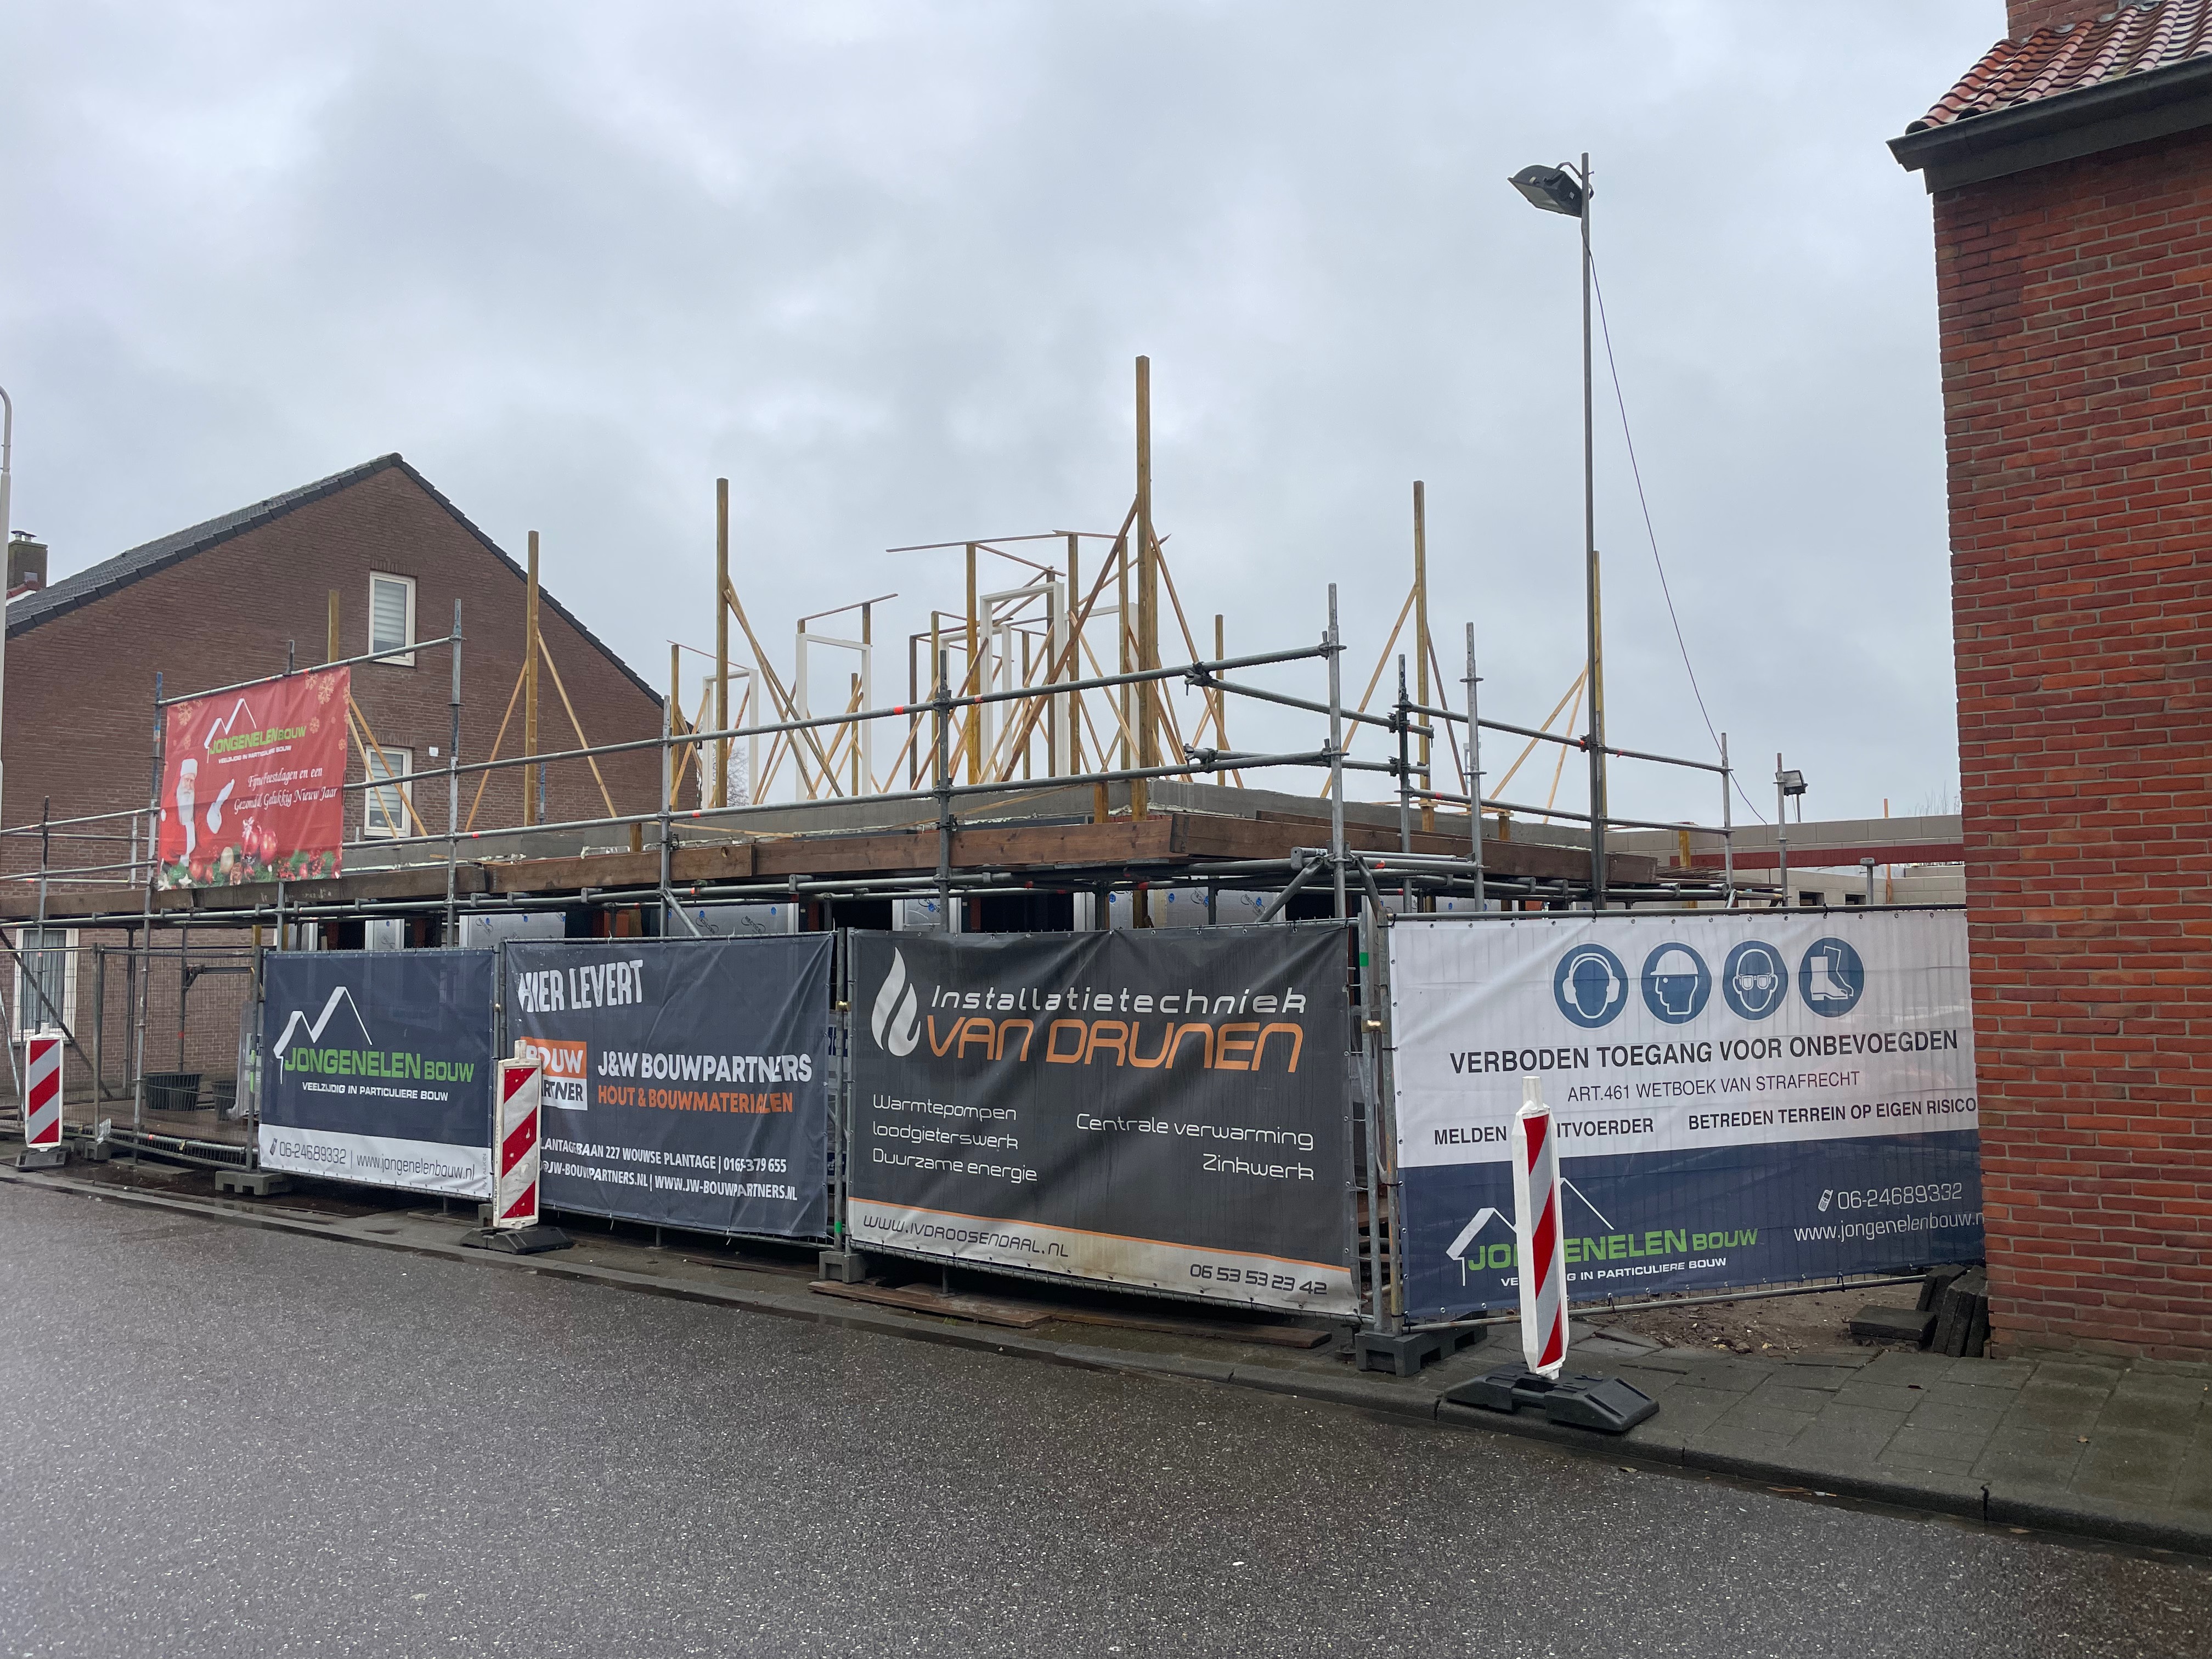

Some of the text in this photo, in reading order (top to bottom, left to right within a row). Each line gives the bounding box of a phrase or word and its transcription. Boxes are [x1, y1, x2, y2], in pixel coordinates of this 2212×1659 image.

[210, 727, 278, 754] JONGENELEN
[300, 769, 308, 779] en
[311, 768, 323, 777] een
[263, 789, 292, 810] Gelukkig
[294, 788, 320, 803] Nieuw
[320, 786, 338, 801] Jaar
[518, 960, 643, 1012] HIER LEVERT
[932, 985, 1306, 1014] Installatietechniek
[927, 1015, 1303, 1073] VAN DRUNEN
[1450, 1029, 1957, 1074] VERBODEN TOEGANG VOOR ONBEVOEGDEN
[285, 1048, 474, 1083] JONGENELEN BOUW
[598, 1051, 812, 1083] J&W BOUWPARTNERS
[302, 1081, 449, 1102] VEELZIJDIG IN PARTICULIERE BOUW
[541, 1080, 584, 1101] RTNER
[598, 1085, 793, 1114] HOUT & BOUWMATERIALEN
[1567, 1071, 1860, 1102] ART.461 WETBOEK VAN STRAFRECHT
[873, 1094, 1016, 1122] Warmtepompen
[1689, 1097, 1976, 1130] BETREDEN TERREIN OP EIGEN RISICO
[1076, 1113, 1314, 1151] Centrale verwarming
[1434, 1118, 1654, 1145] MELDEN ITVOERDER
[357, 1153, 475, 1181] www.jongenelenbouw.nl
[540, 1138, 603, 1158] LANTAGEBAAN
[606, 1146, 620, 1159] 227
[622, 1148, 661, 1164] WOUWSE
[664, 1152, 715, 1169] PLANTAGE
[768, 1158, 787, 1173] 655
[873, 1148, 1037, 1184] Duurzame energie
[1203, 1153, 1314, 1181] Zinkwerk
[540, 1160, 648, 1187] @JW-BOUWPARTNERS.NL
[654, 1175, 798, 1201] WWW.JW-BOUWPARTNERS.NL
[1838, 1183, 1962, 1210] 06-24689332
[1794, 1212, 1983, 1243] www.jongenelenbouw.n
[1468, 1228, 1758, 1271] JOENELEN BOUW
[1190, 1263, 1327, 1295] 06 53 53 23 42
[1581, 1271, 1593, 1281] IN
[1598, 1262, 1685, 1279] PARTICULIERE
[1689, 1257, 1726, 1269] BOUW
